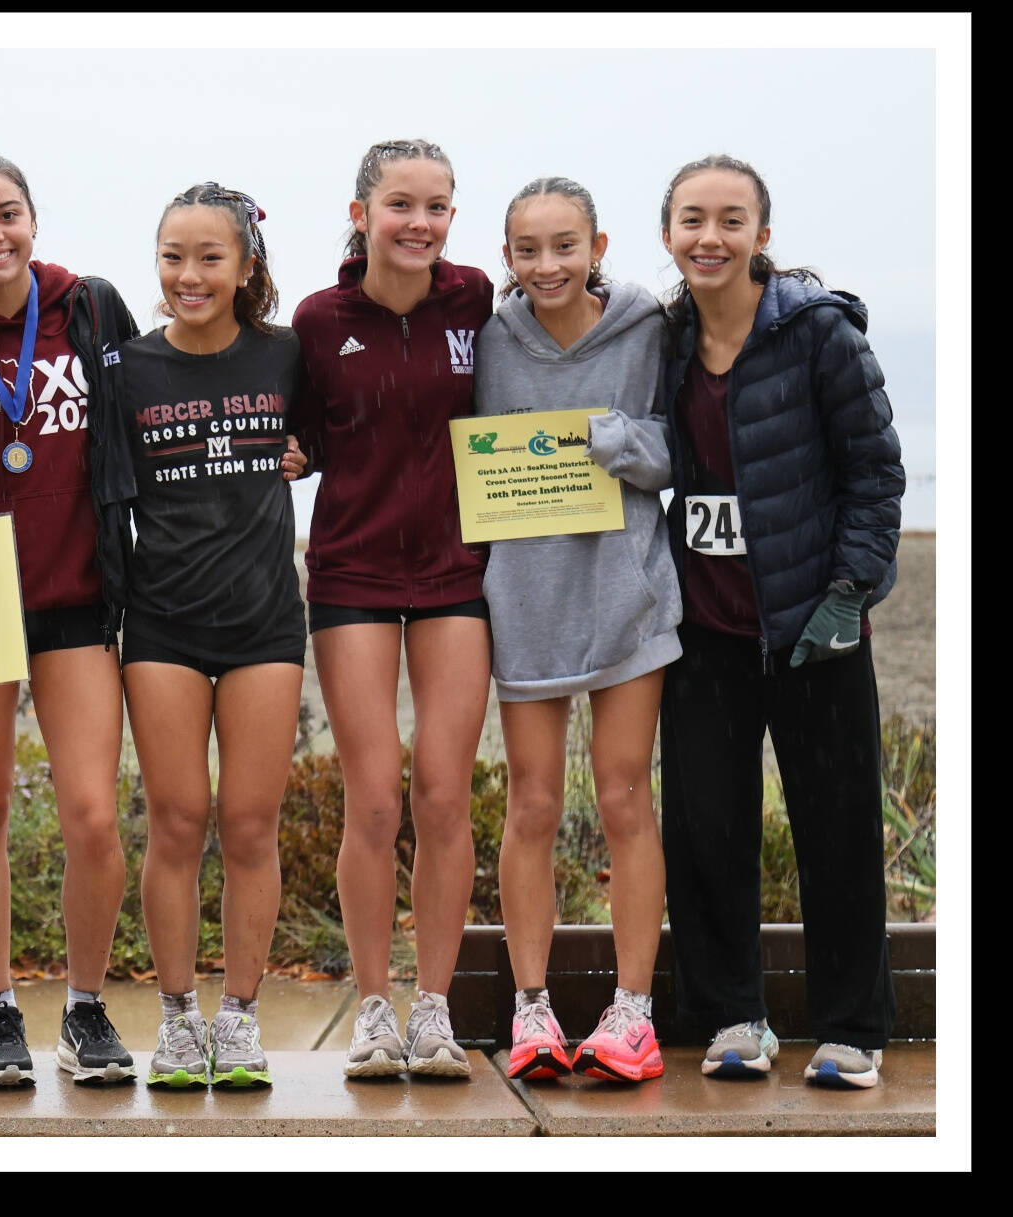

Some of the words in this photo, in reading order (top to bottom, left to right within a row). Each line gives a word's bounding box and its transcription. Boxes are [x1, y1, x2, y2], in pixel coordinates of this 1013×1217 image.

[135, 399, 215, 429] MERCER
[143, 423, 197, 444] CROSS
[155, 464, 198, 483] STATE
[204, 459, 246, 477] TEAM
[477, 468, 497, 476] Girls
[510, 465, 522, 473] All
[526, 463, 558, 472] SeaKing
[558, 460, 589, 469] District
[507, 476, 539, 484] Country
[540, 473, 568, 481] Second
[487, 490, 510, 500] 10th
[511, 488, 538, 497] Place
[539, 482, 593, 495] Individual
